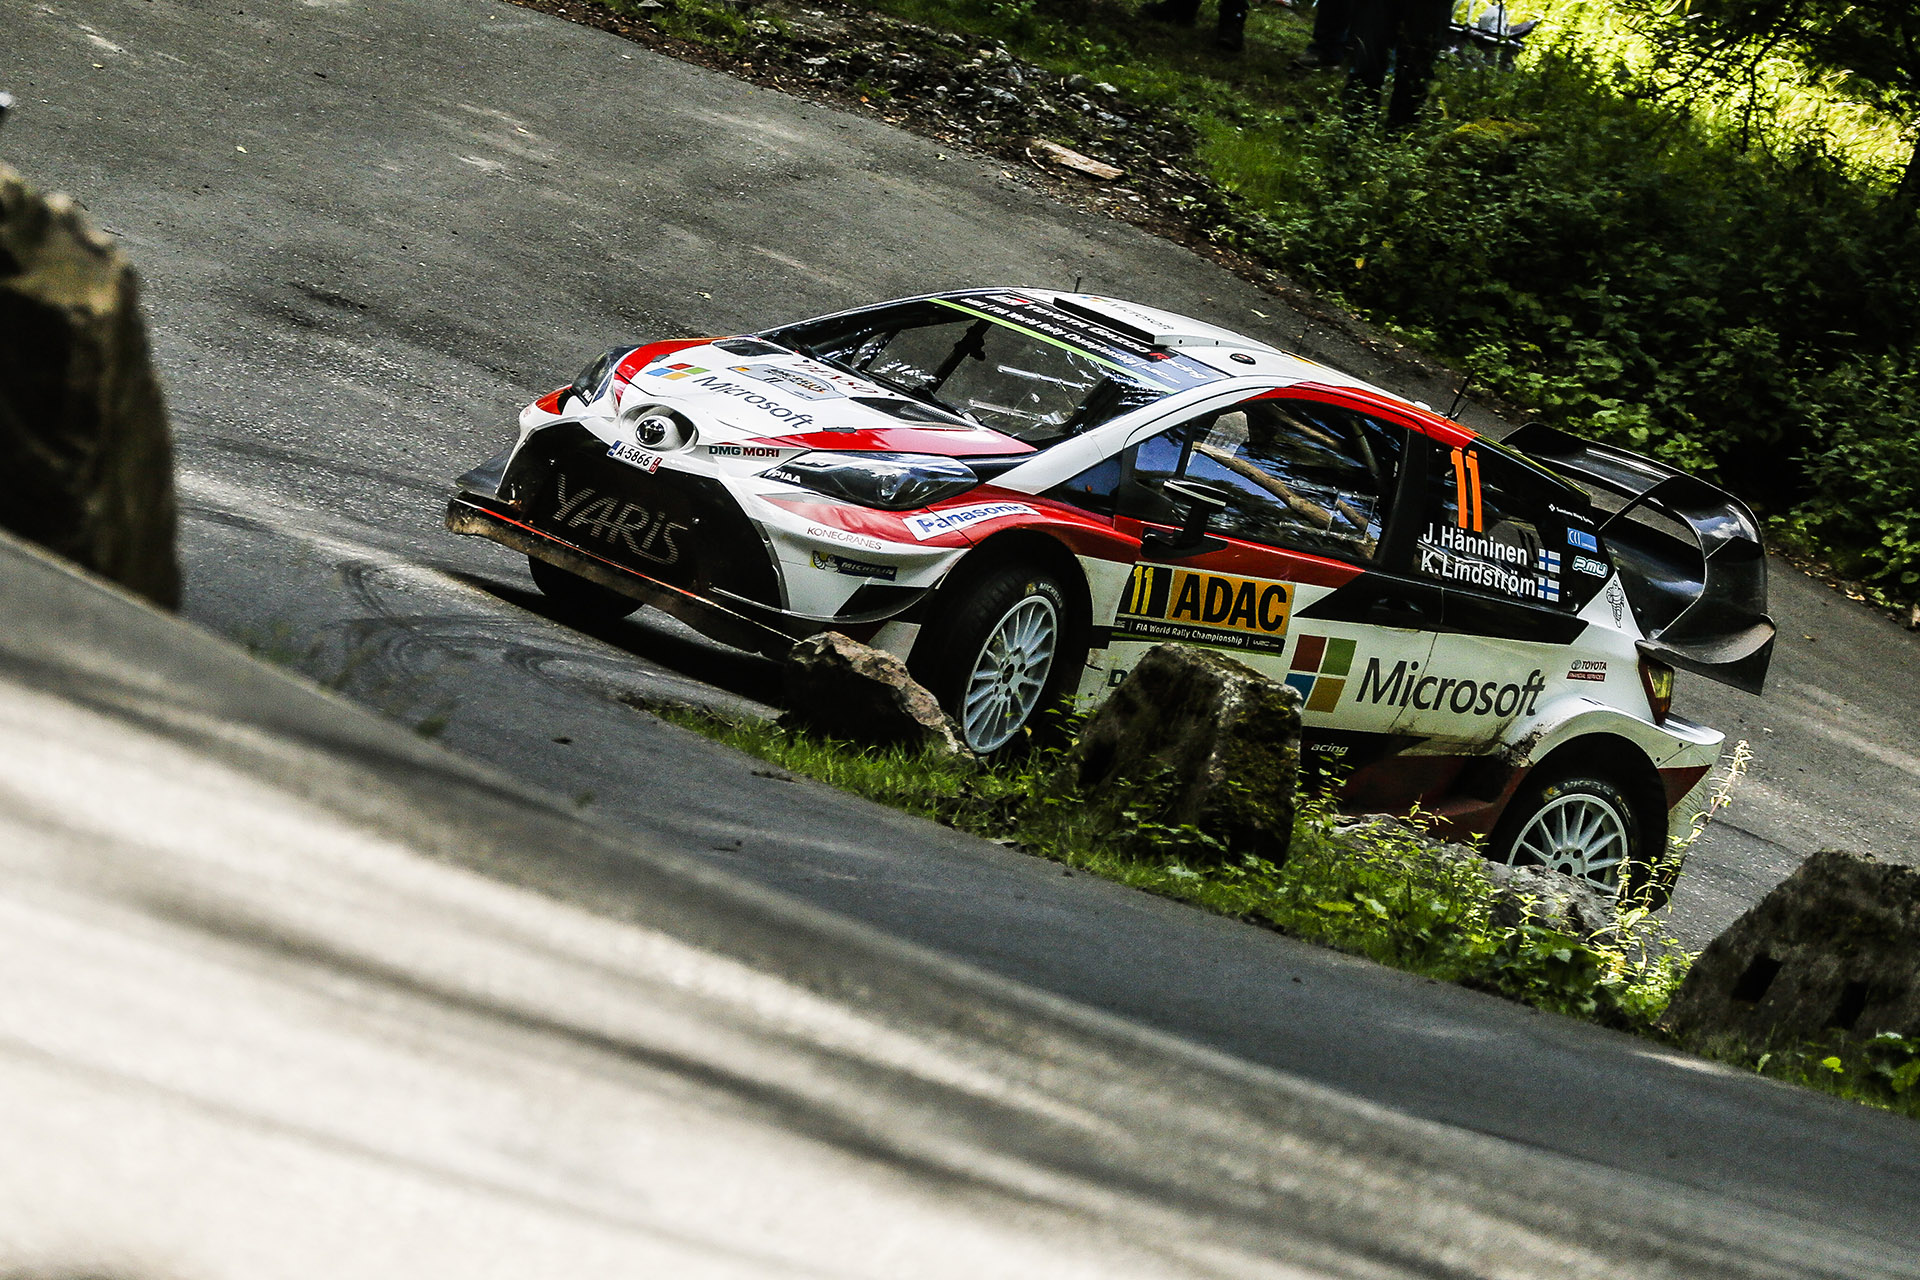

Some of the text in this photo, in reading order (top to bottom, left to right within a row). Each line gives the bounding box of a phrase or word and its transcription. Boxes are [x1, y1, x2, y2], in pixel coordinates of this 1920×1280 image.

[1007, 312, 1041, 326] World
[1036, 323, 1067, 336] Rally
[1064, 333, 1137, 366] Championship
[1024, 304, 1208, 380] TOYOTA GAZOO Racing
[692, 375, 814, 429] Microsoft
[708, 445, 780, 458] DMG MORI
[772, 469, 801, 484] PIAA
[1450, 446, 1483, 533] 11
[916, 502, 1028, 533] Panasonic
[806, 526, 882, 551] KONECRANES
[840, 561, 897, 576] MICHELIN
[1129, 565, 1154, 616] 11
[1172, 573, 1287, 632] ADAC
[1135, 622, 1148, 632] FIA
[1149, 625, 1171, 635] World
[1171, 628, 1191, 639] Rally
[1191, 629, 1243, 646] Championship
[1582, 660, 1607, 670] TOYOTA
[1356, 657, 1546, 717] Microsoft
